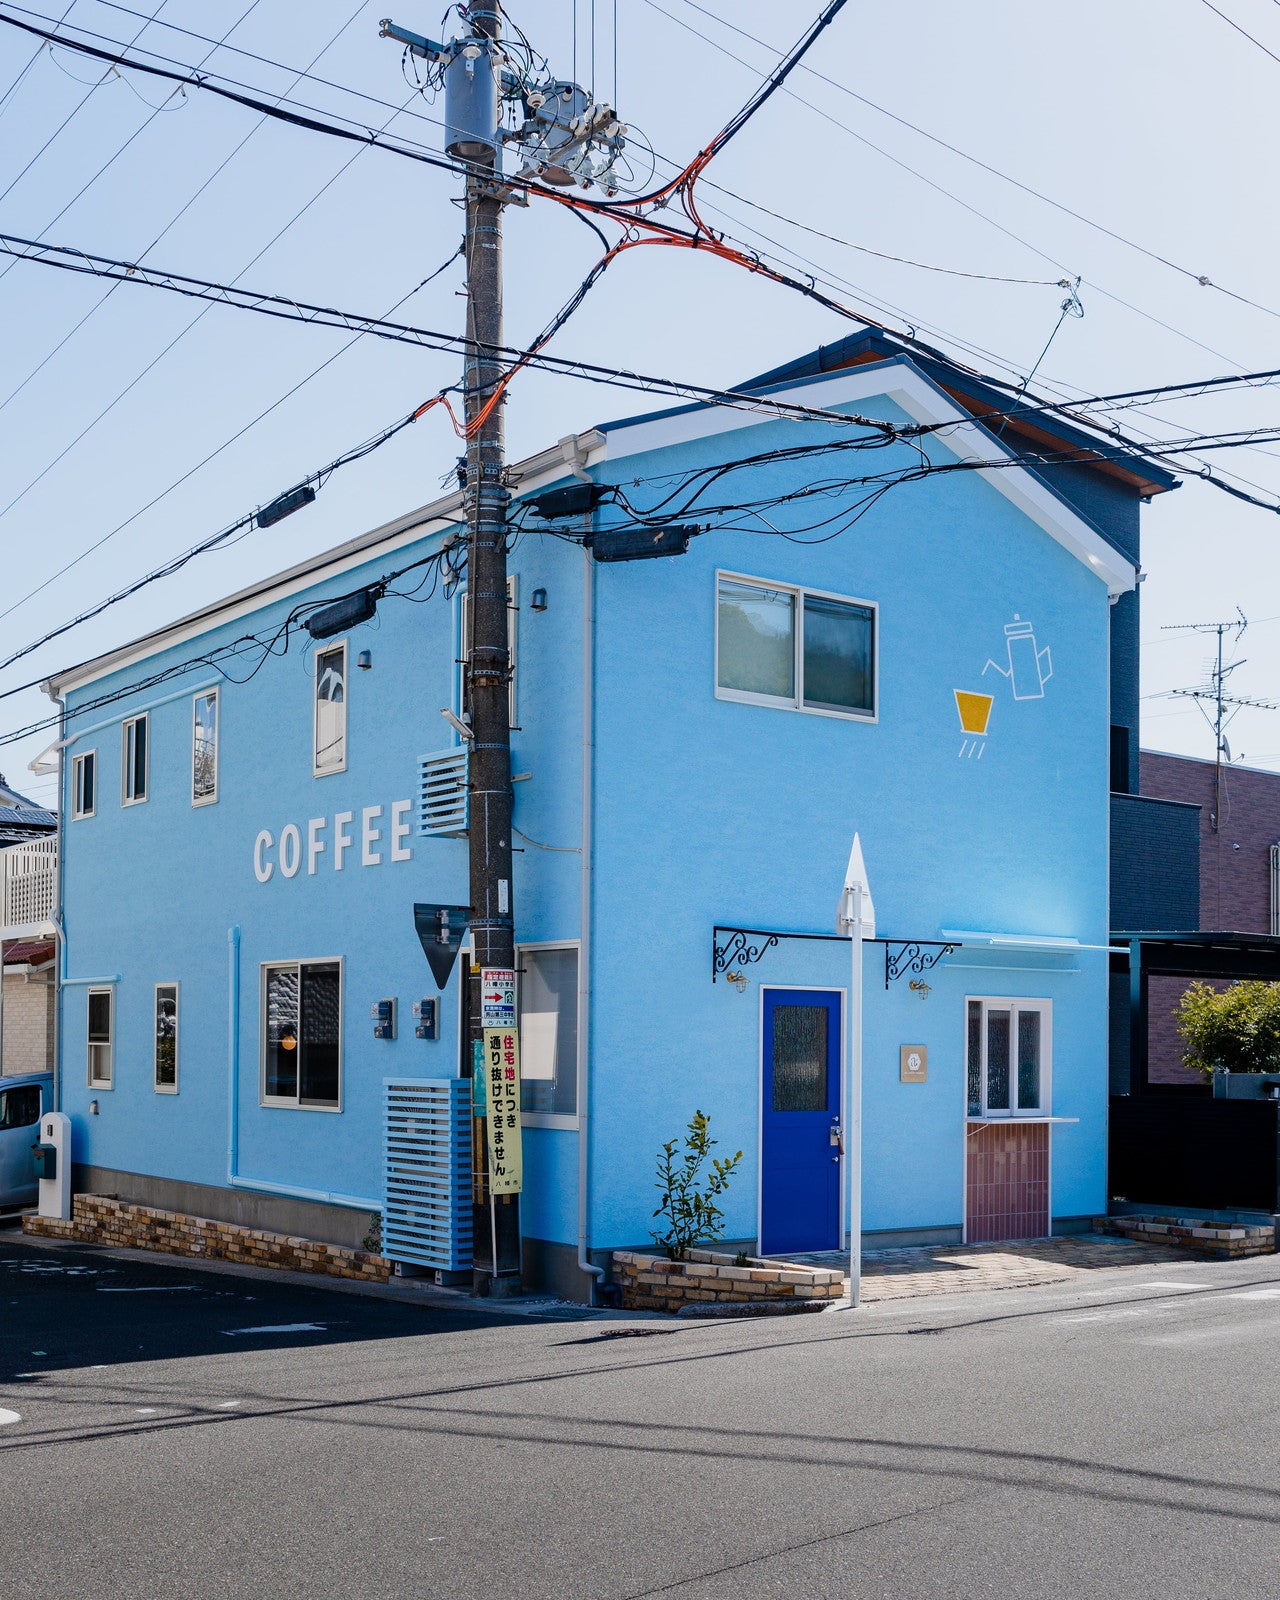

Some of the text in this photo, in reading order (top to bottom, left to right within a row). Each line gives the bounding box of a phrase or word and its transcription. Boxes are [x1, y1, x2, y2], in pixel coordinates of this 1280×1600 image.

[254, 799, 413, 883] COFFEE
[489, 1035, 506, 1177] 通り抜けできません
[503, 1035, 516, 1128] 住宅地につき
